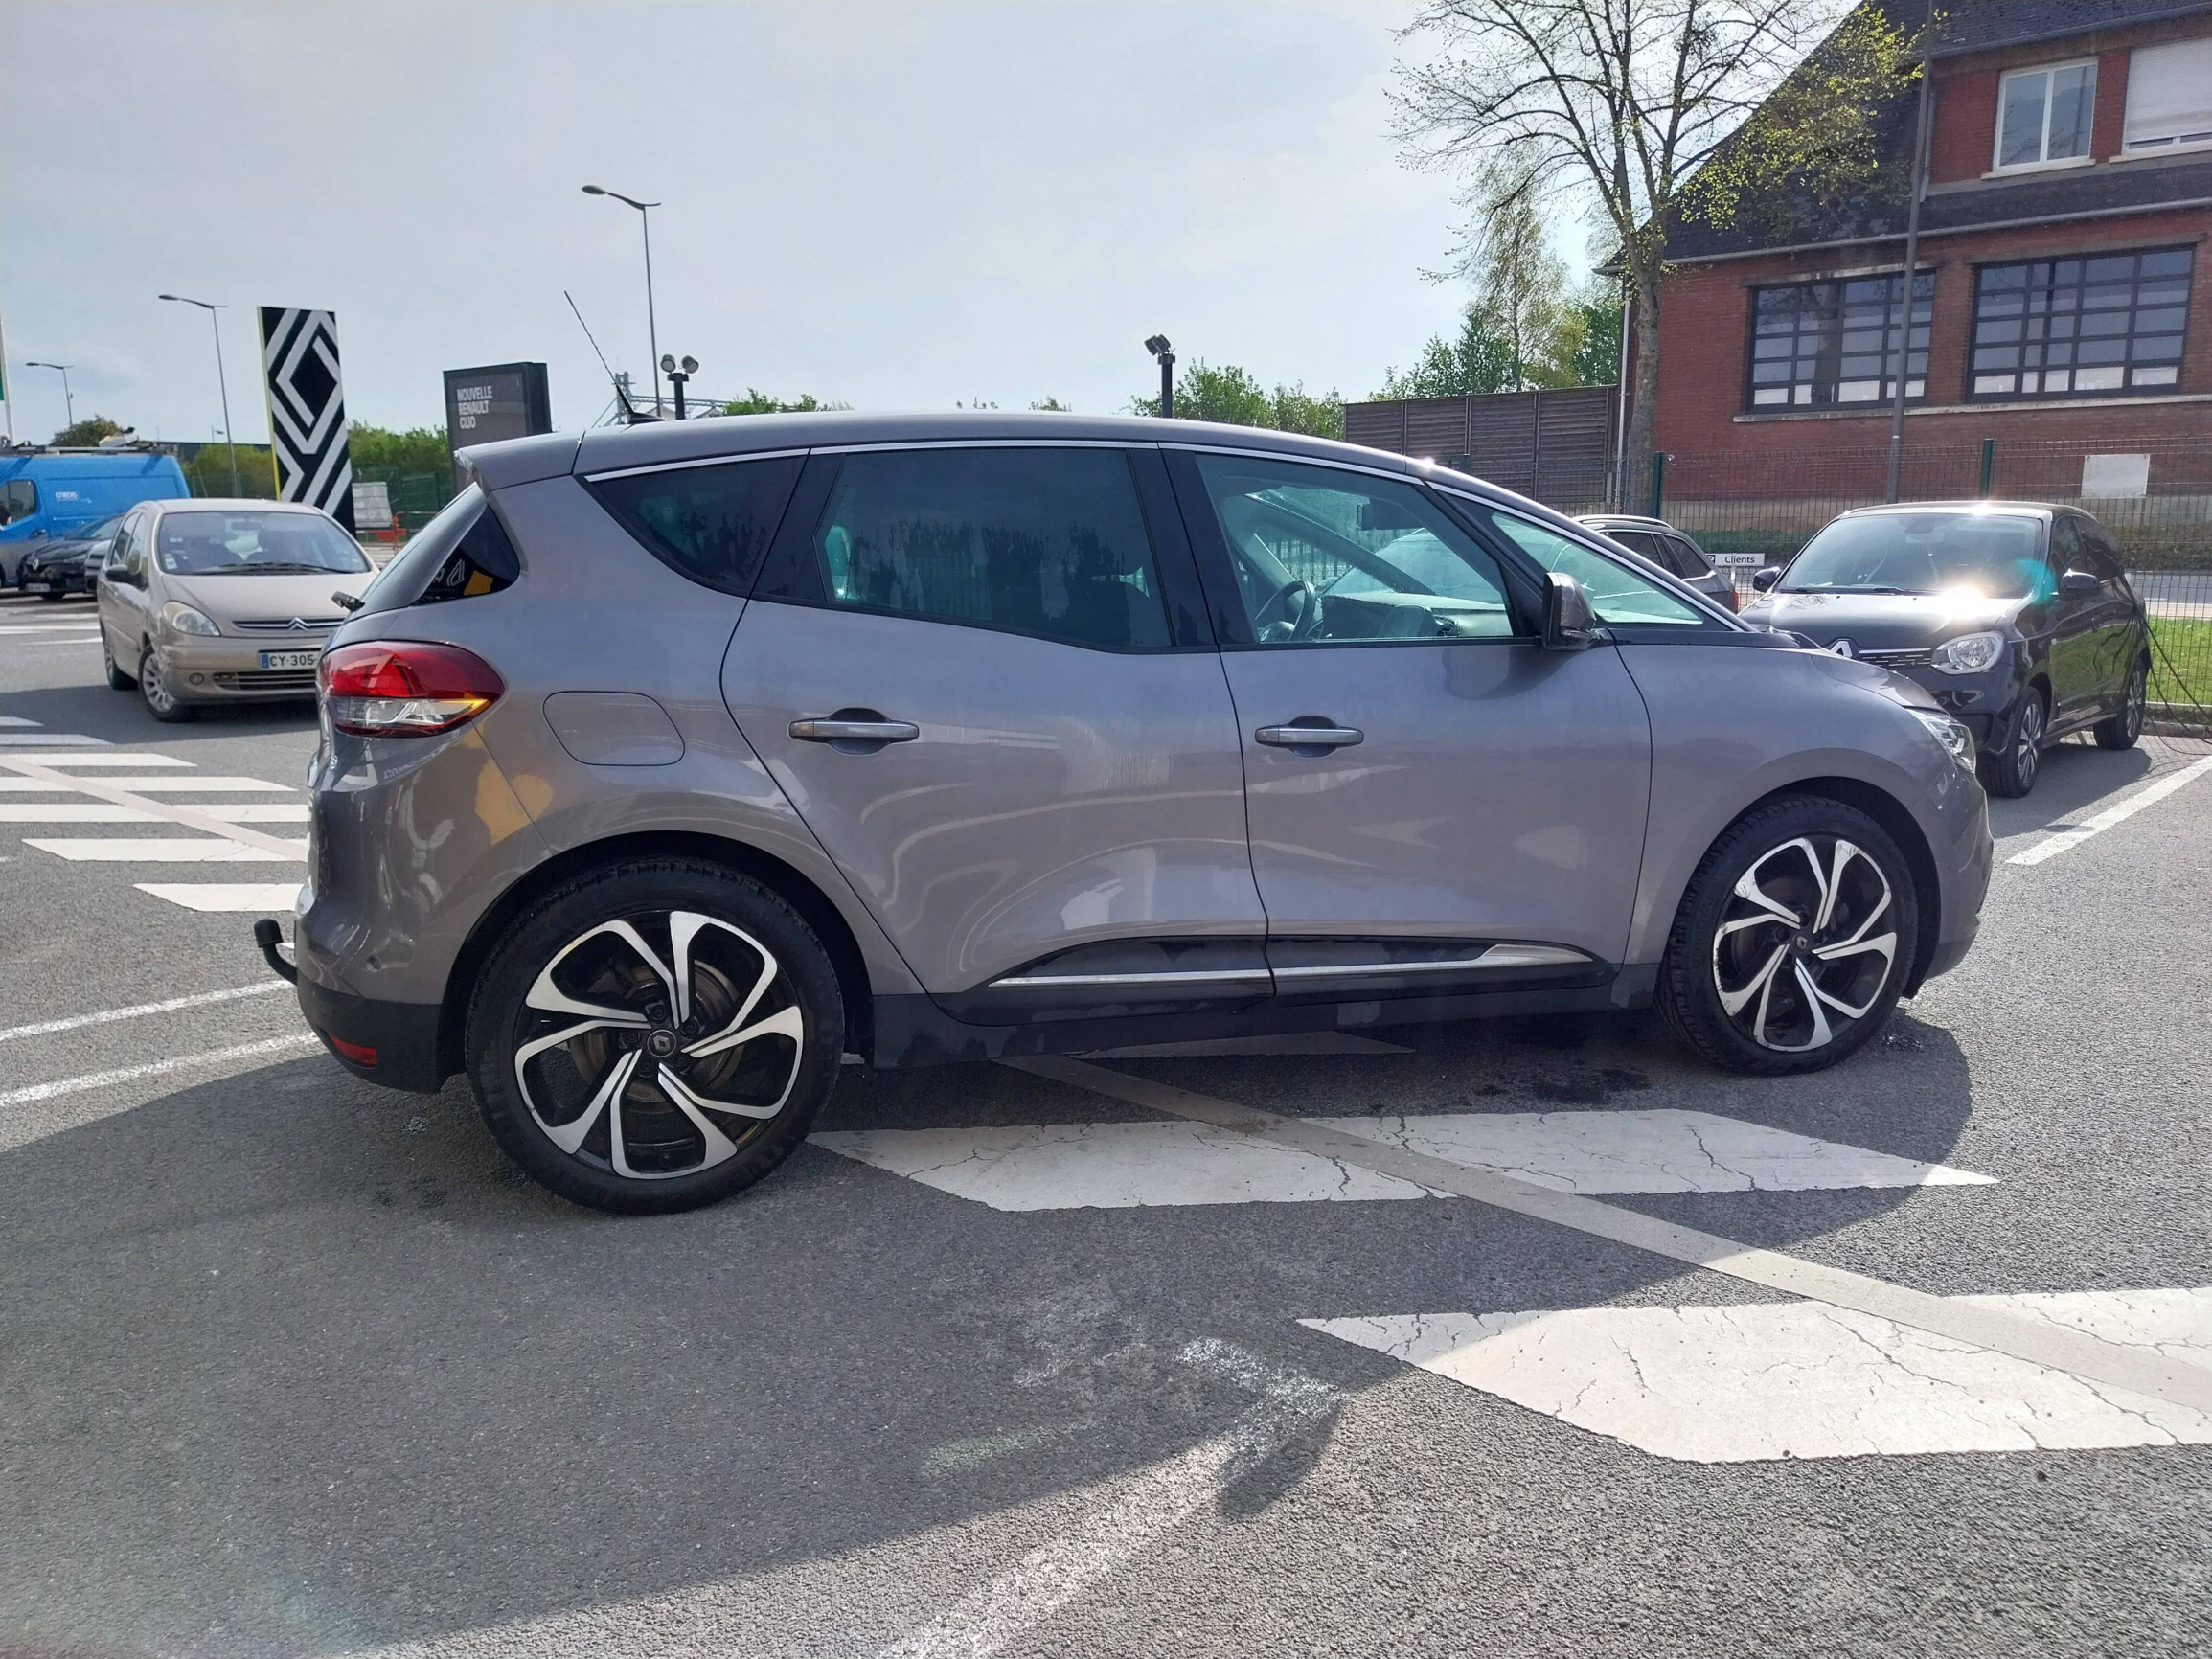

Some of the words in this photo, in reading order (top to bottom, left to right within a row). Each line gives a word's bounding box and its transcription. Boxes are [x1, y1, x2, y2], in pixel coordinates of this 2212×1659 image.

[457, 386, 492, 400] NOUVELLE
[459, 400, 489, 415] RENAULT
[460, 416, 476, 429] CLIO
